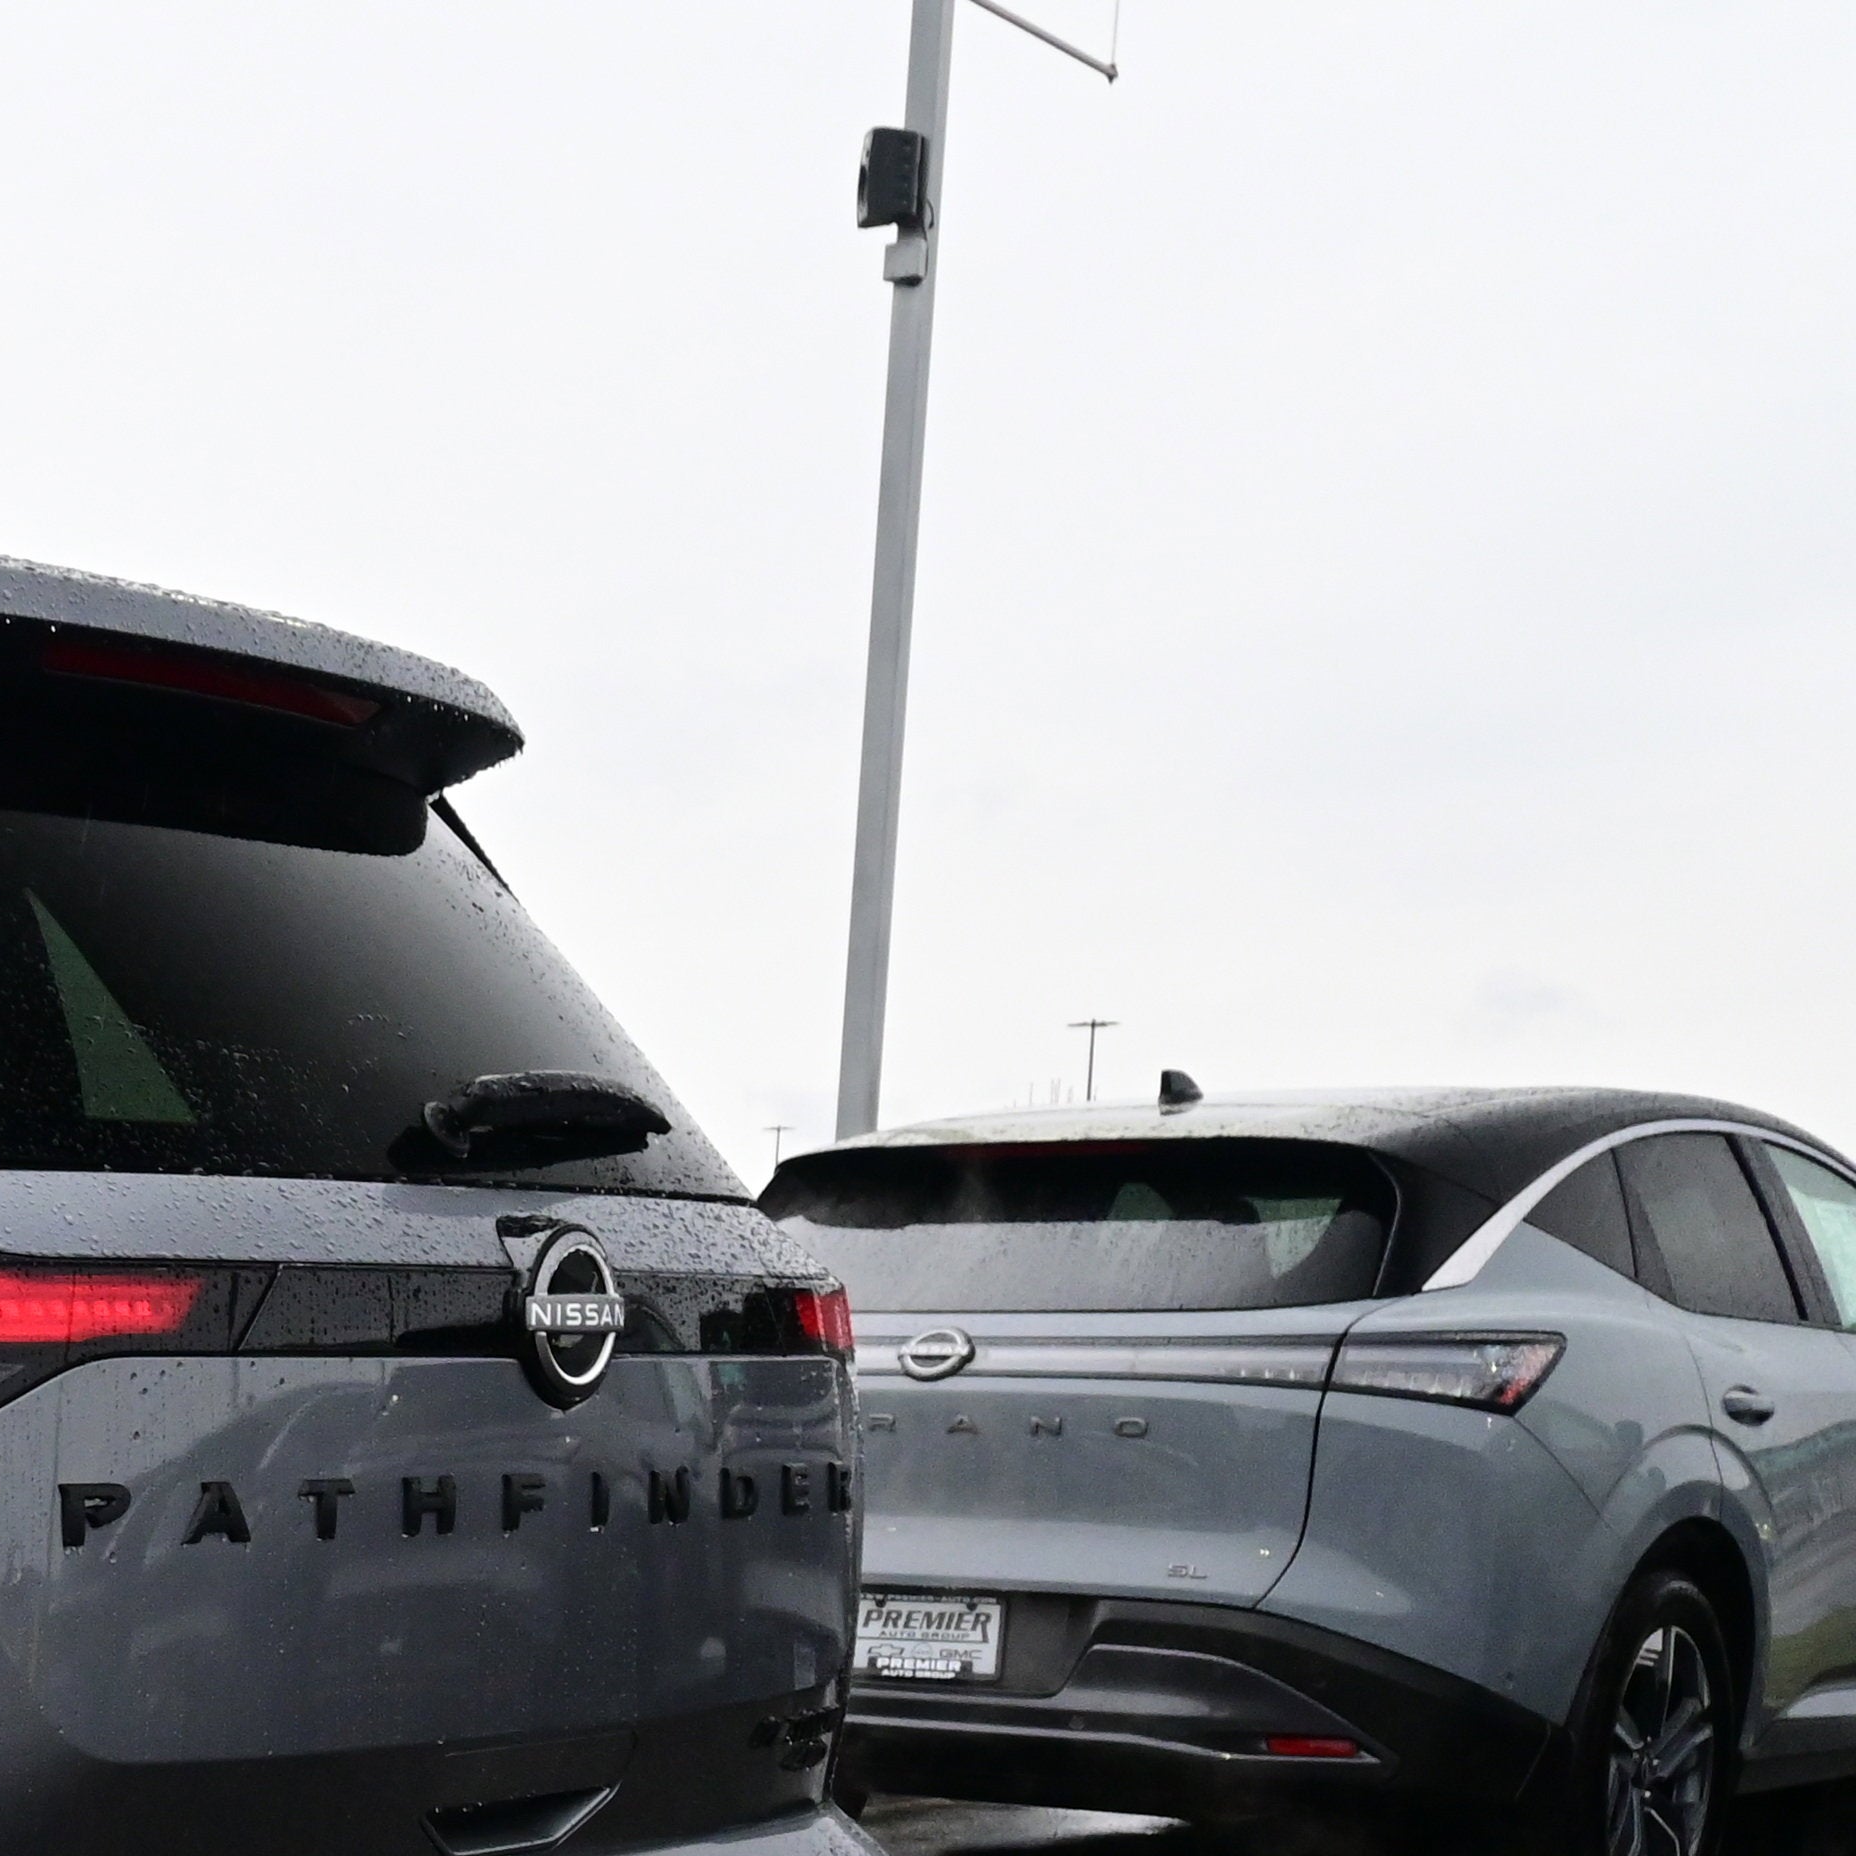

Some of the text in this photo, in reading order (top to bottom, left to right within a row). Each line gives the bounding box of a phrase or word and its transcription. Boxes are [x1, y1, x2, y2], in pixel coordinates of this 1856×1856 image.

[530, 1302, 625, 1328] NISSAN
[58, 1460, 852, 1548] PATHFINDER
[862, 1608, 992, 1643] PREMIER
[879, 1630, 970, 1641] AUTO GROUP
[940, 1648, 983, 1660] GMC
[876, 1656, 961, 1672] PREMIER
[881, 1669, 913, 1677] AUTO
